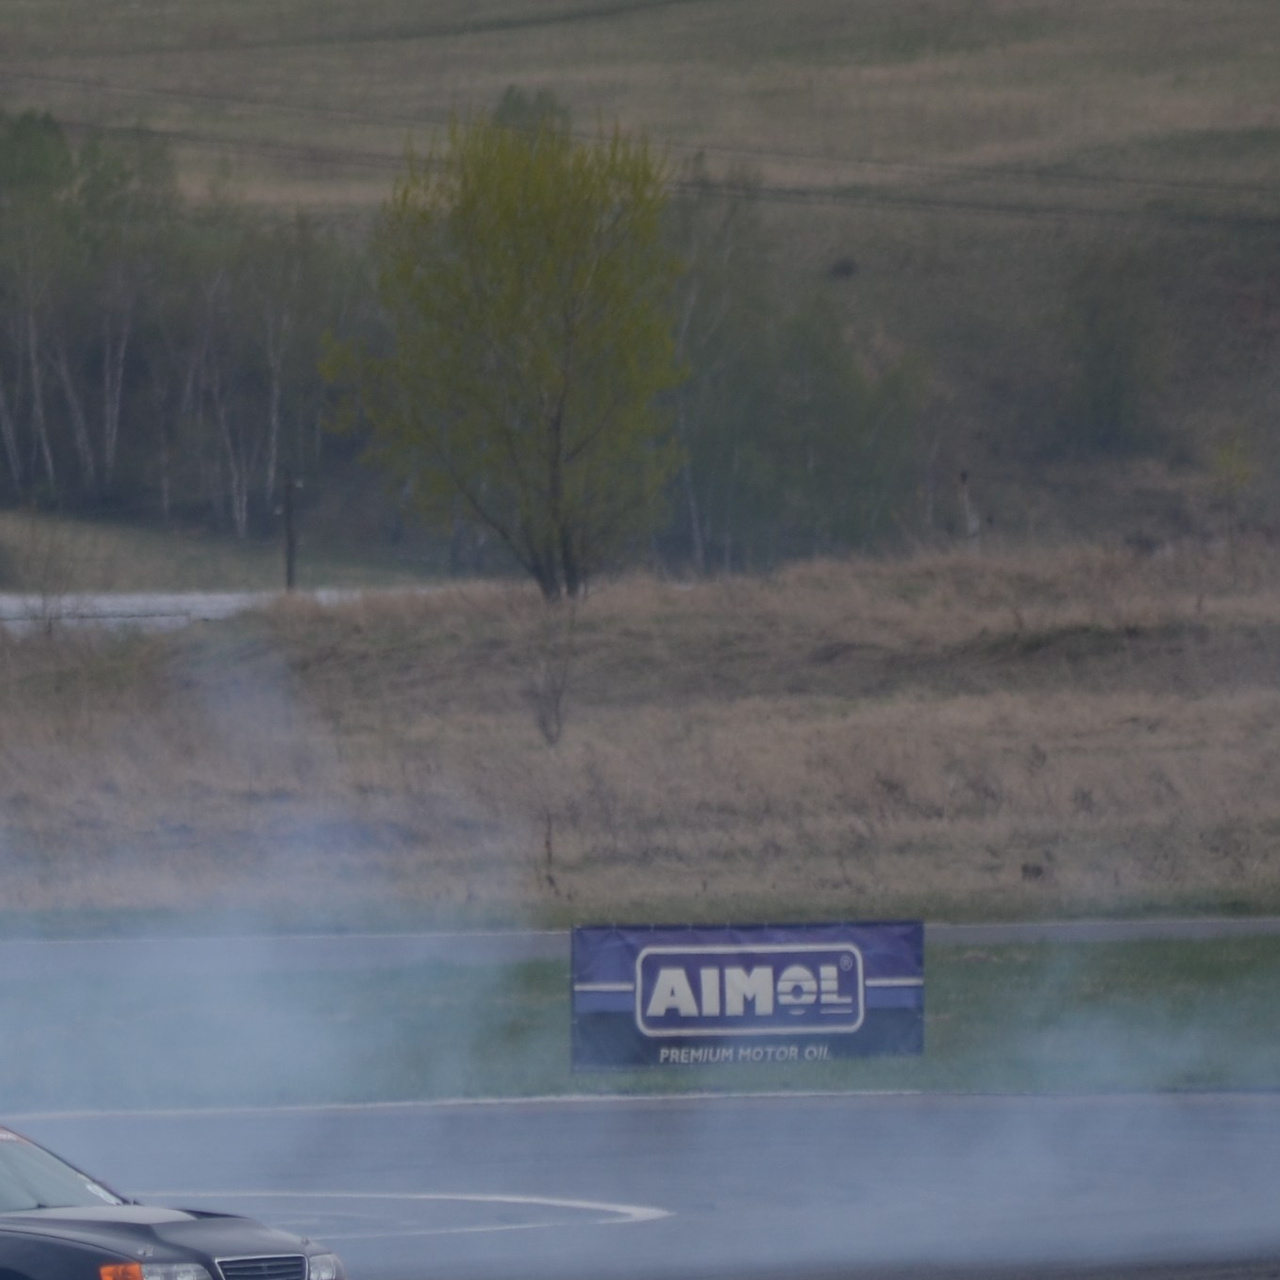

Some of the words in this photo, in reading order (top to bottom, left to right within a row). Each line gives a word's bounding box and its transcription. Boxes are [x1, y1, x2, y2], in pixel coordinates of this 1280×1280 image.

[645, 964, 853, 1017] AIMOL
[659, 1047, 734, 1064] PREMIUM
[737, 1047, 798, 1062] MOTOR
[804, 1046, 829, 1061] OIL
